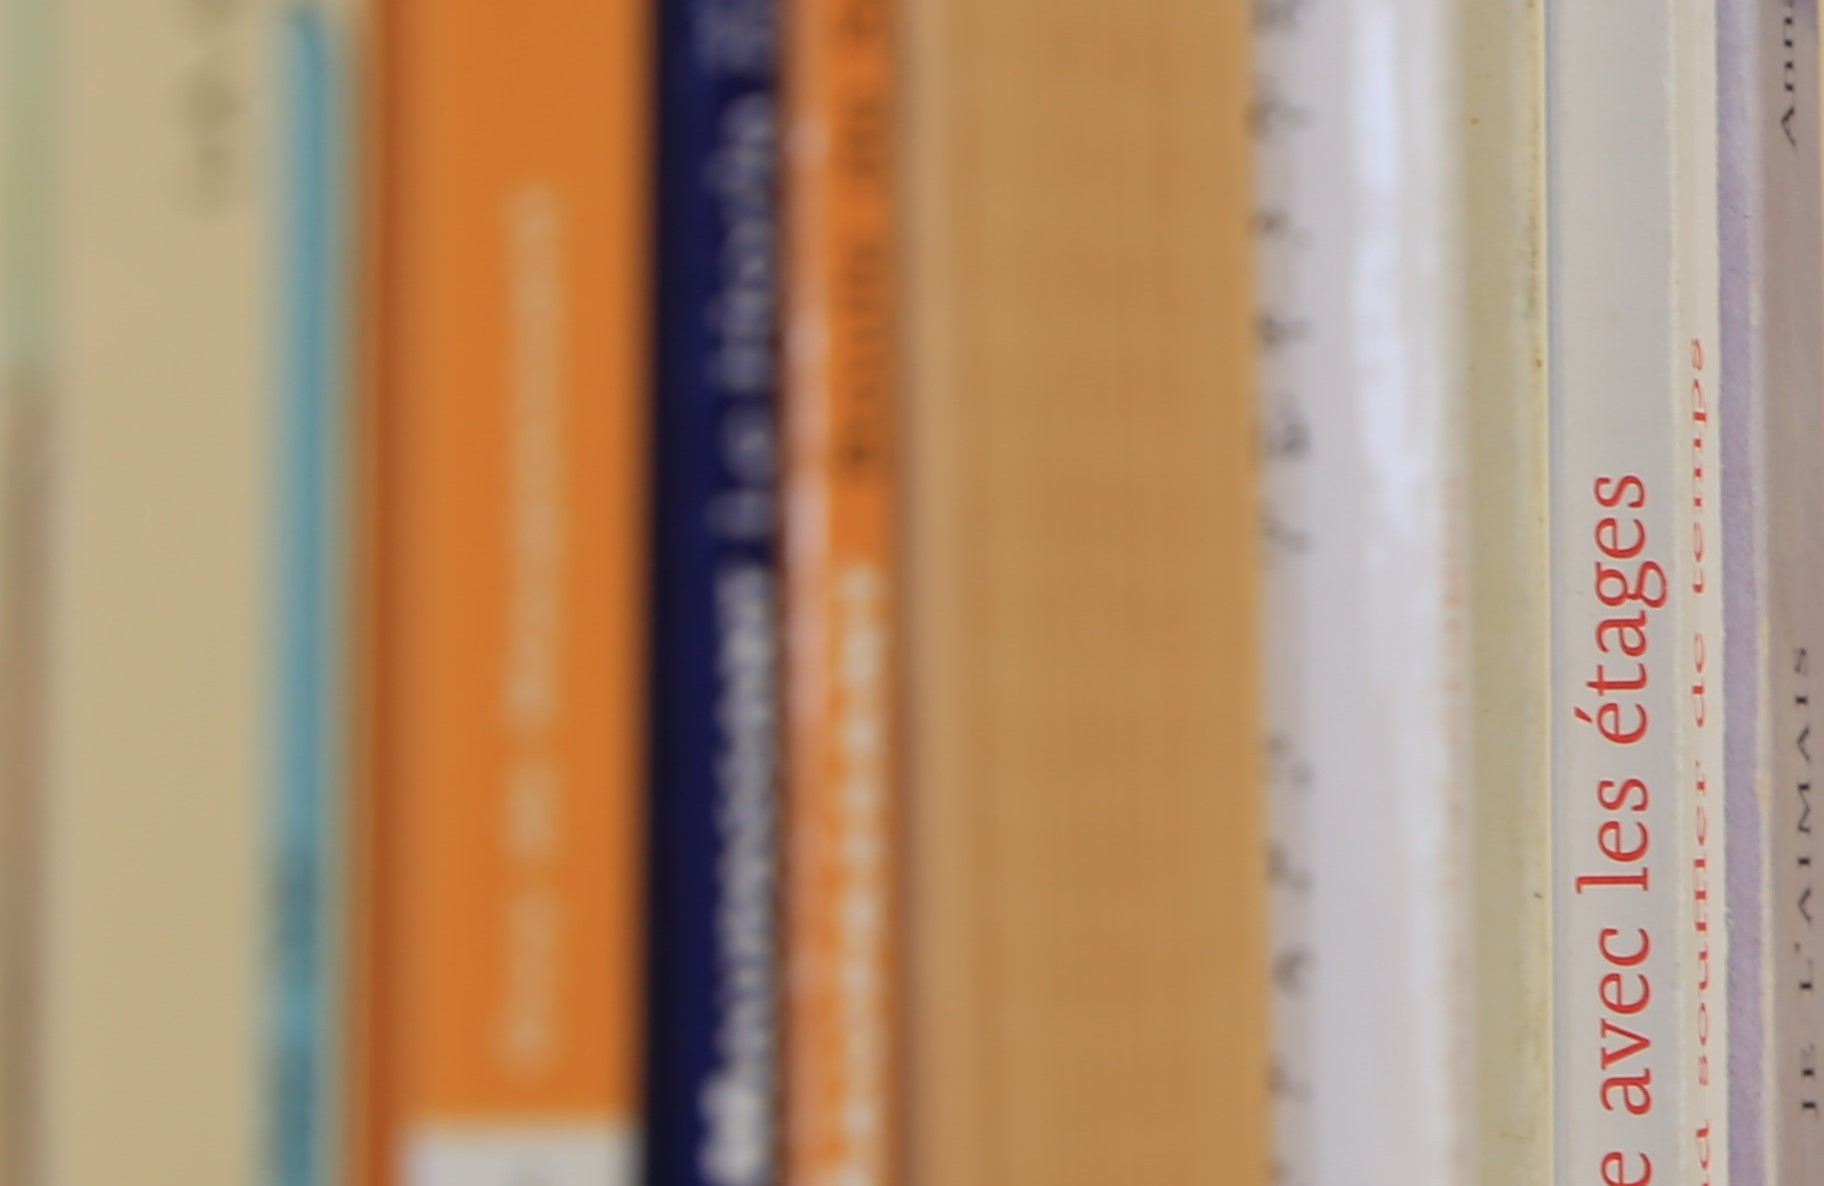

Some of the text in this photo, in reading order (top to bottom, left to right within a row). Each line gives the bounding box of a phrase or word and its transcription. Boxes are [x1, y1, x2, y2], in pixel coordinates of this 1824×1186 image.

[1778, 0, 1798, 152] Ann
[1686, 337, 1713, 598] temps
[1572, 473, 1671, 747] étages
[1687, 632, 1711, 731] de
[1573, 776, 1652, 894] les
[1688, 760, 1714, 1090] souffler
[1596, 926, 1655, 1118] avec
[1799, 1041, 1820, 1123] JE
